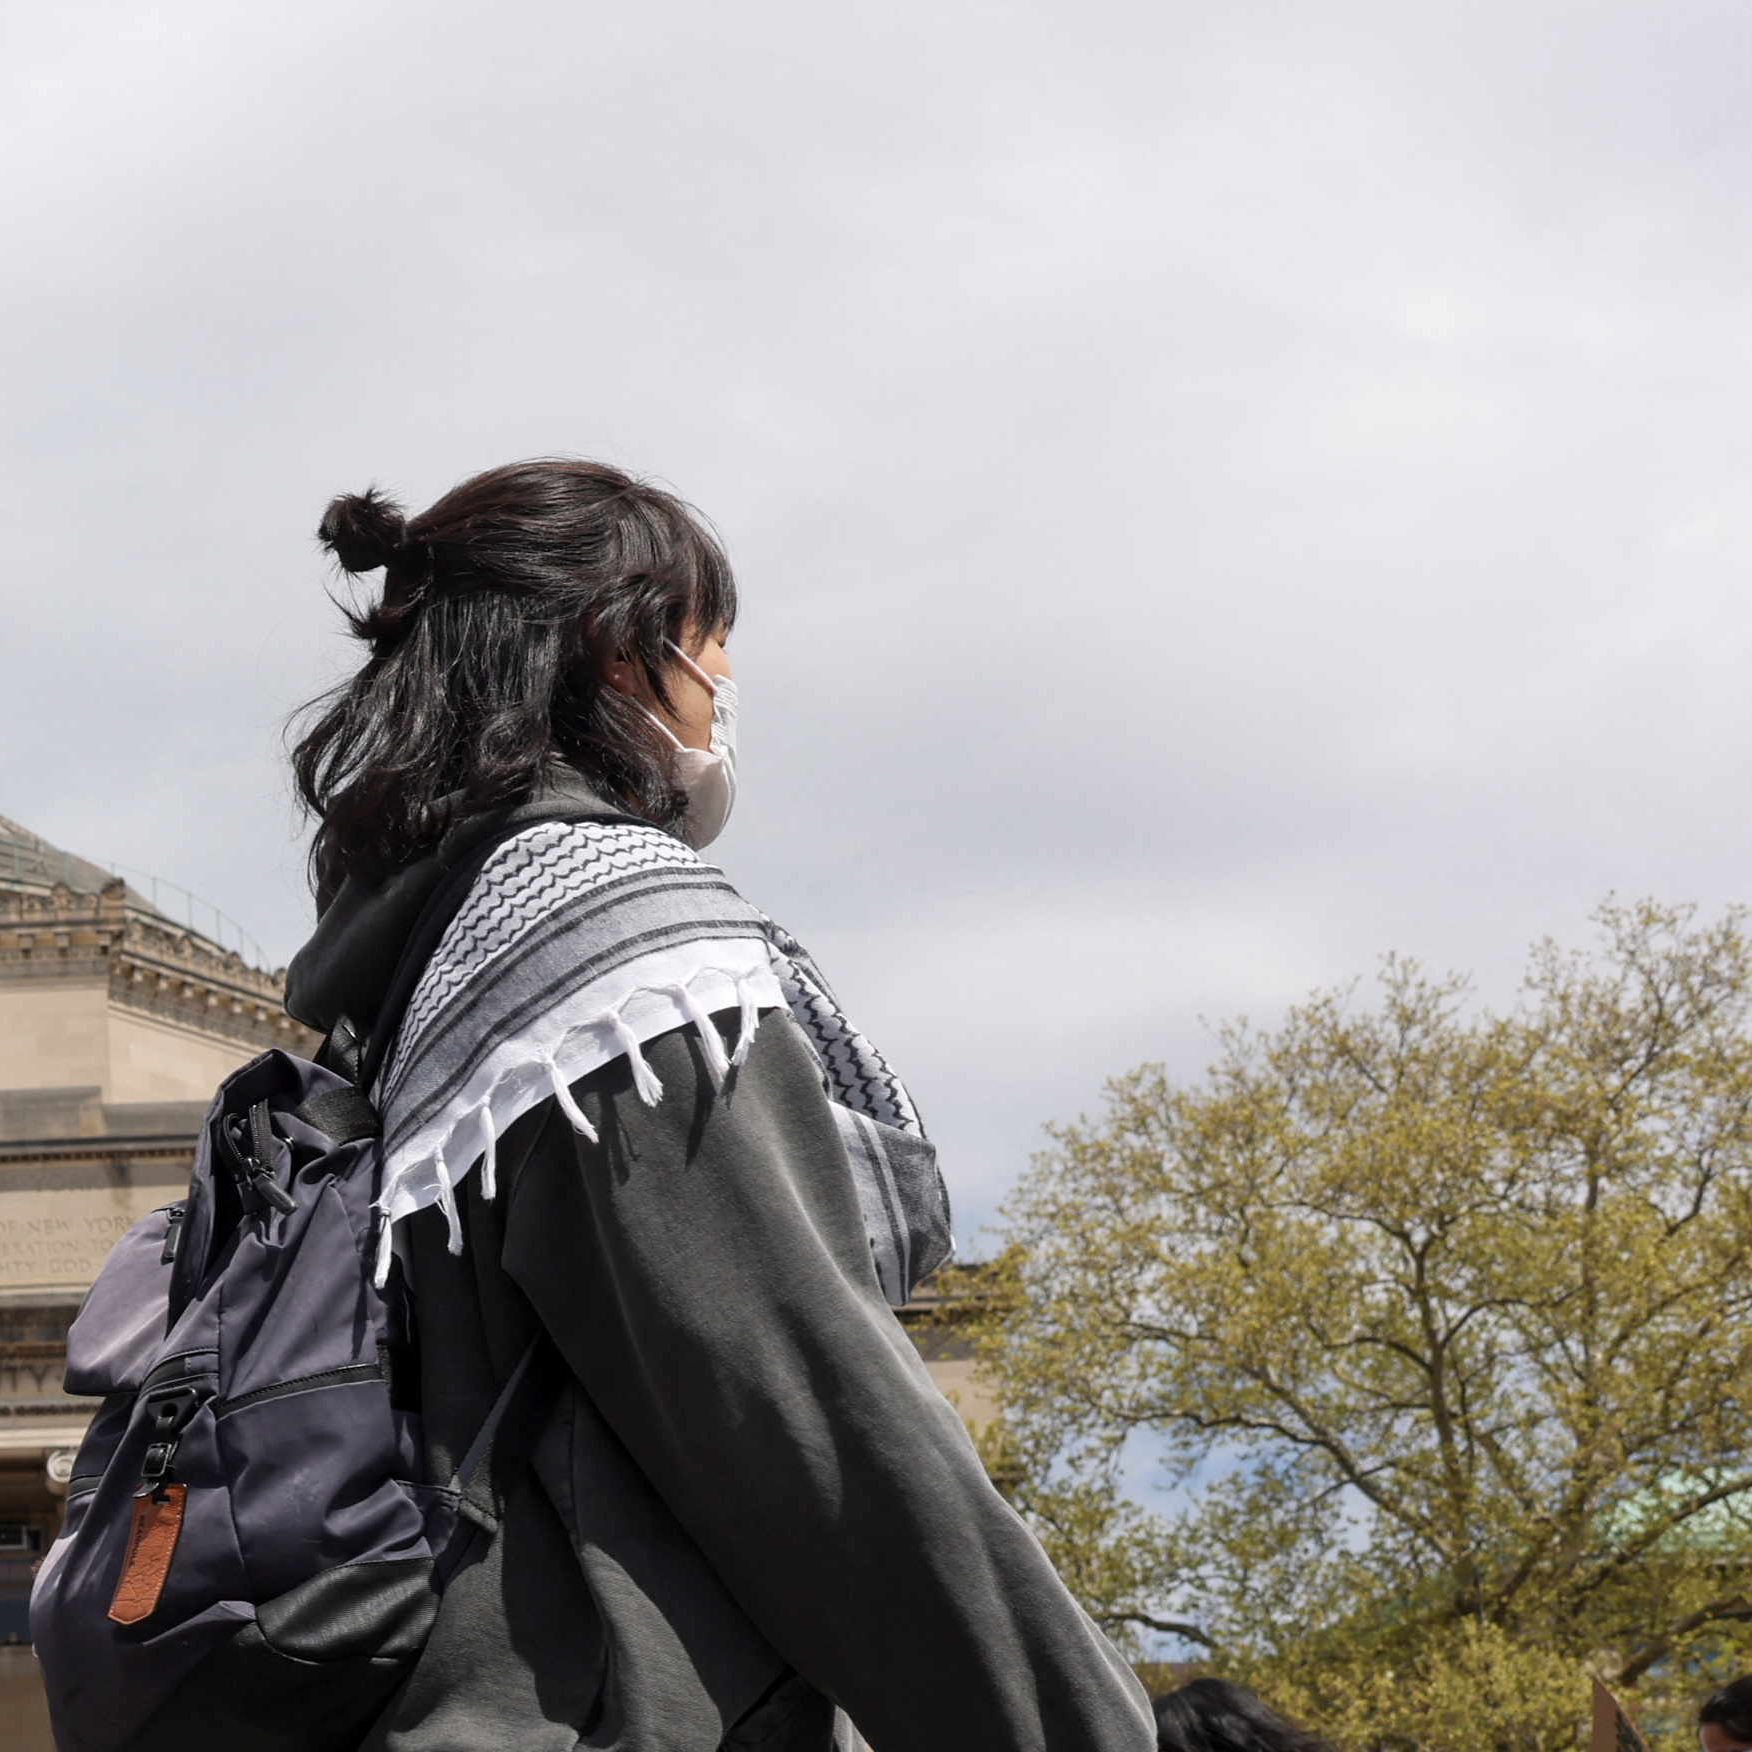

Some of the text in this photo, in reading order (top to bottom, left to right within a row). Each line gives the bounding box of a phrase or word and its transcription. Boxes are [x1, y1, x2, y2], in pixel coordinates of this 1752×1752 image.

[27, 1218, 74, 1236] NEW
[89, 1238, 114, 1254] TO
[49, 1257, 92, 1275] GOD
